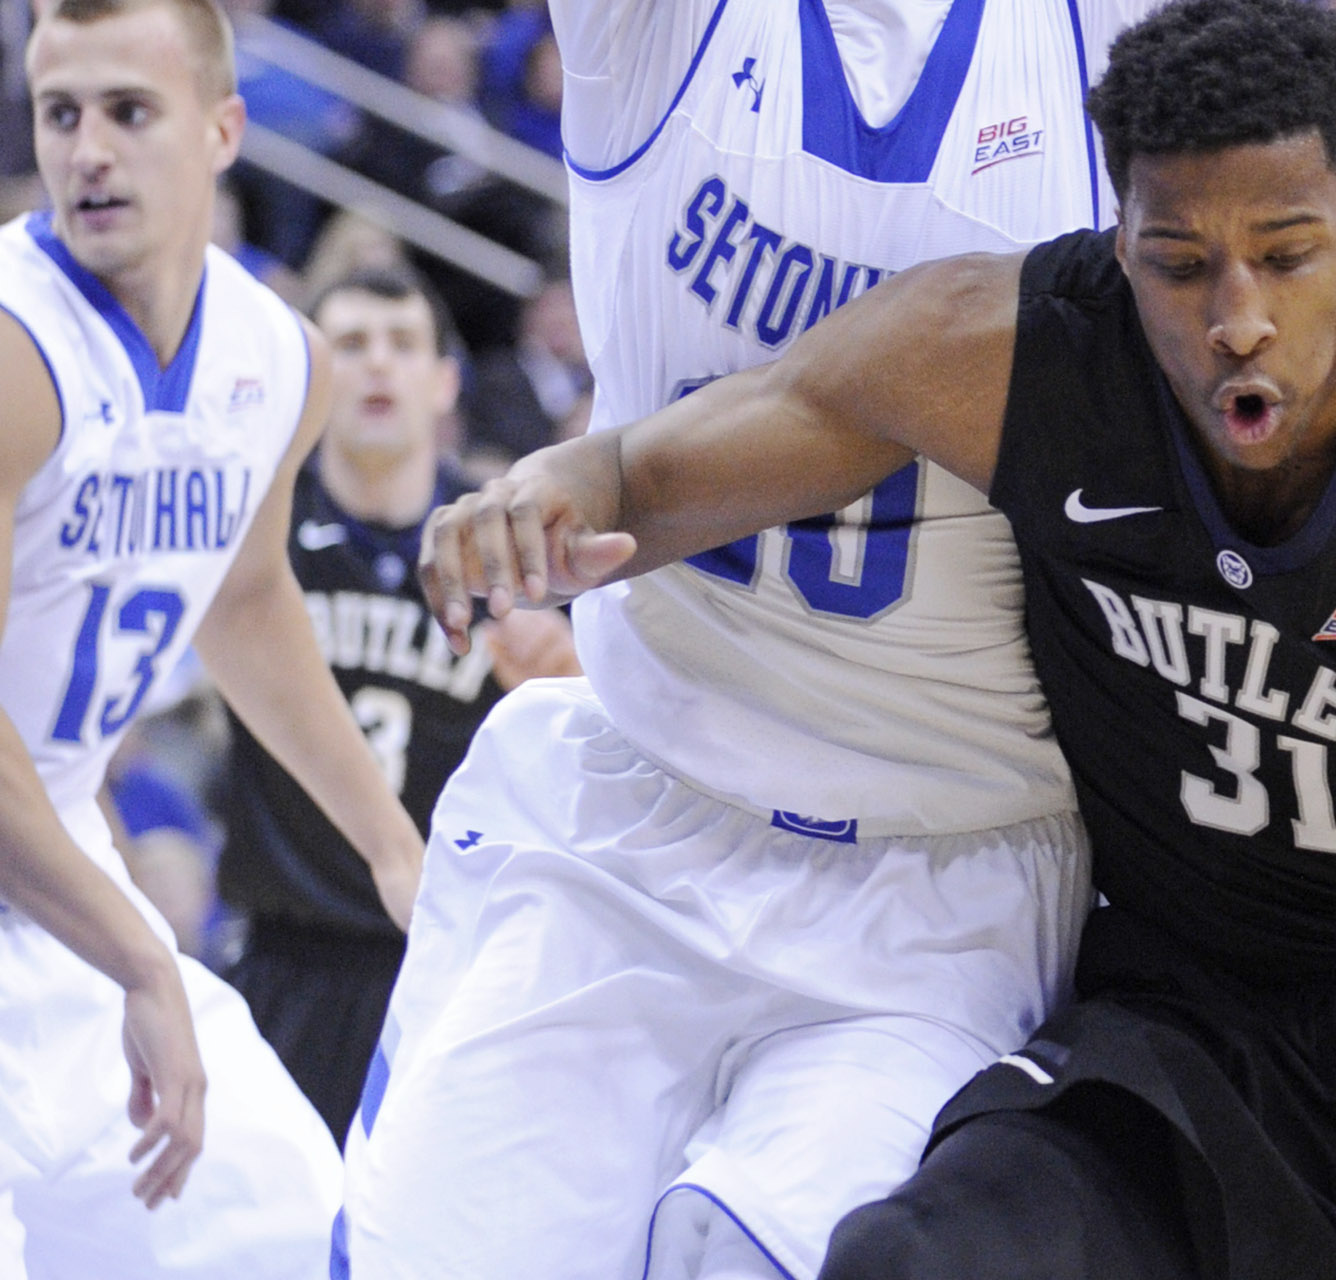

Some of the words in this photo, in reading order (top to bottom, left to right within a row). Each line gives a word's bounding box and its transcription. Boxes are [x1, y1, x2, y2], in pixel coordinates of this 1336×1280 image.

[978, 116, 1027, 144] BIG
[975, 131, 1043, 162] EAST
[48, 581, 186, 743] 13
